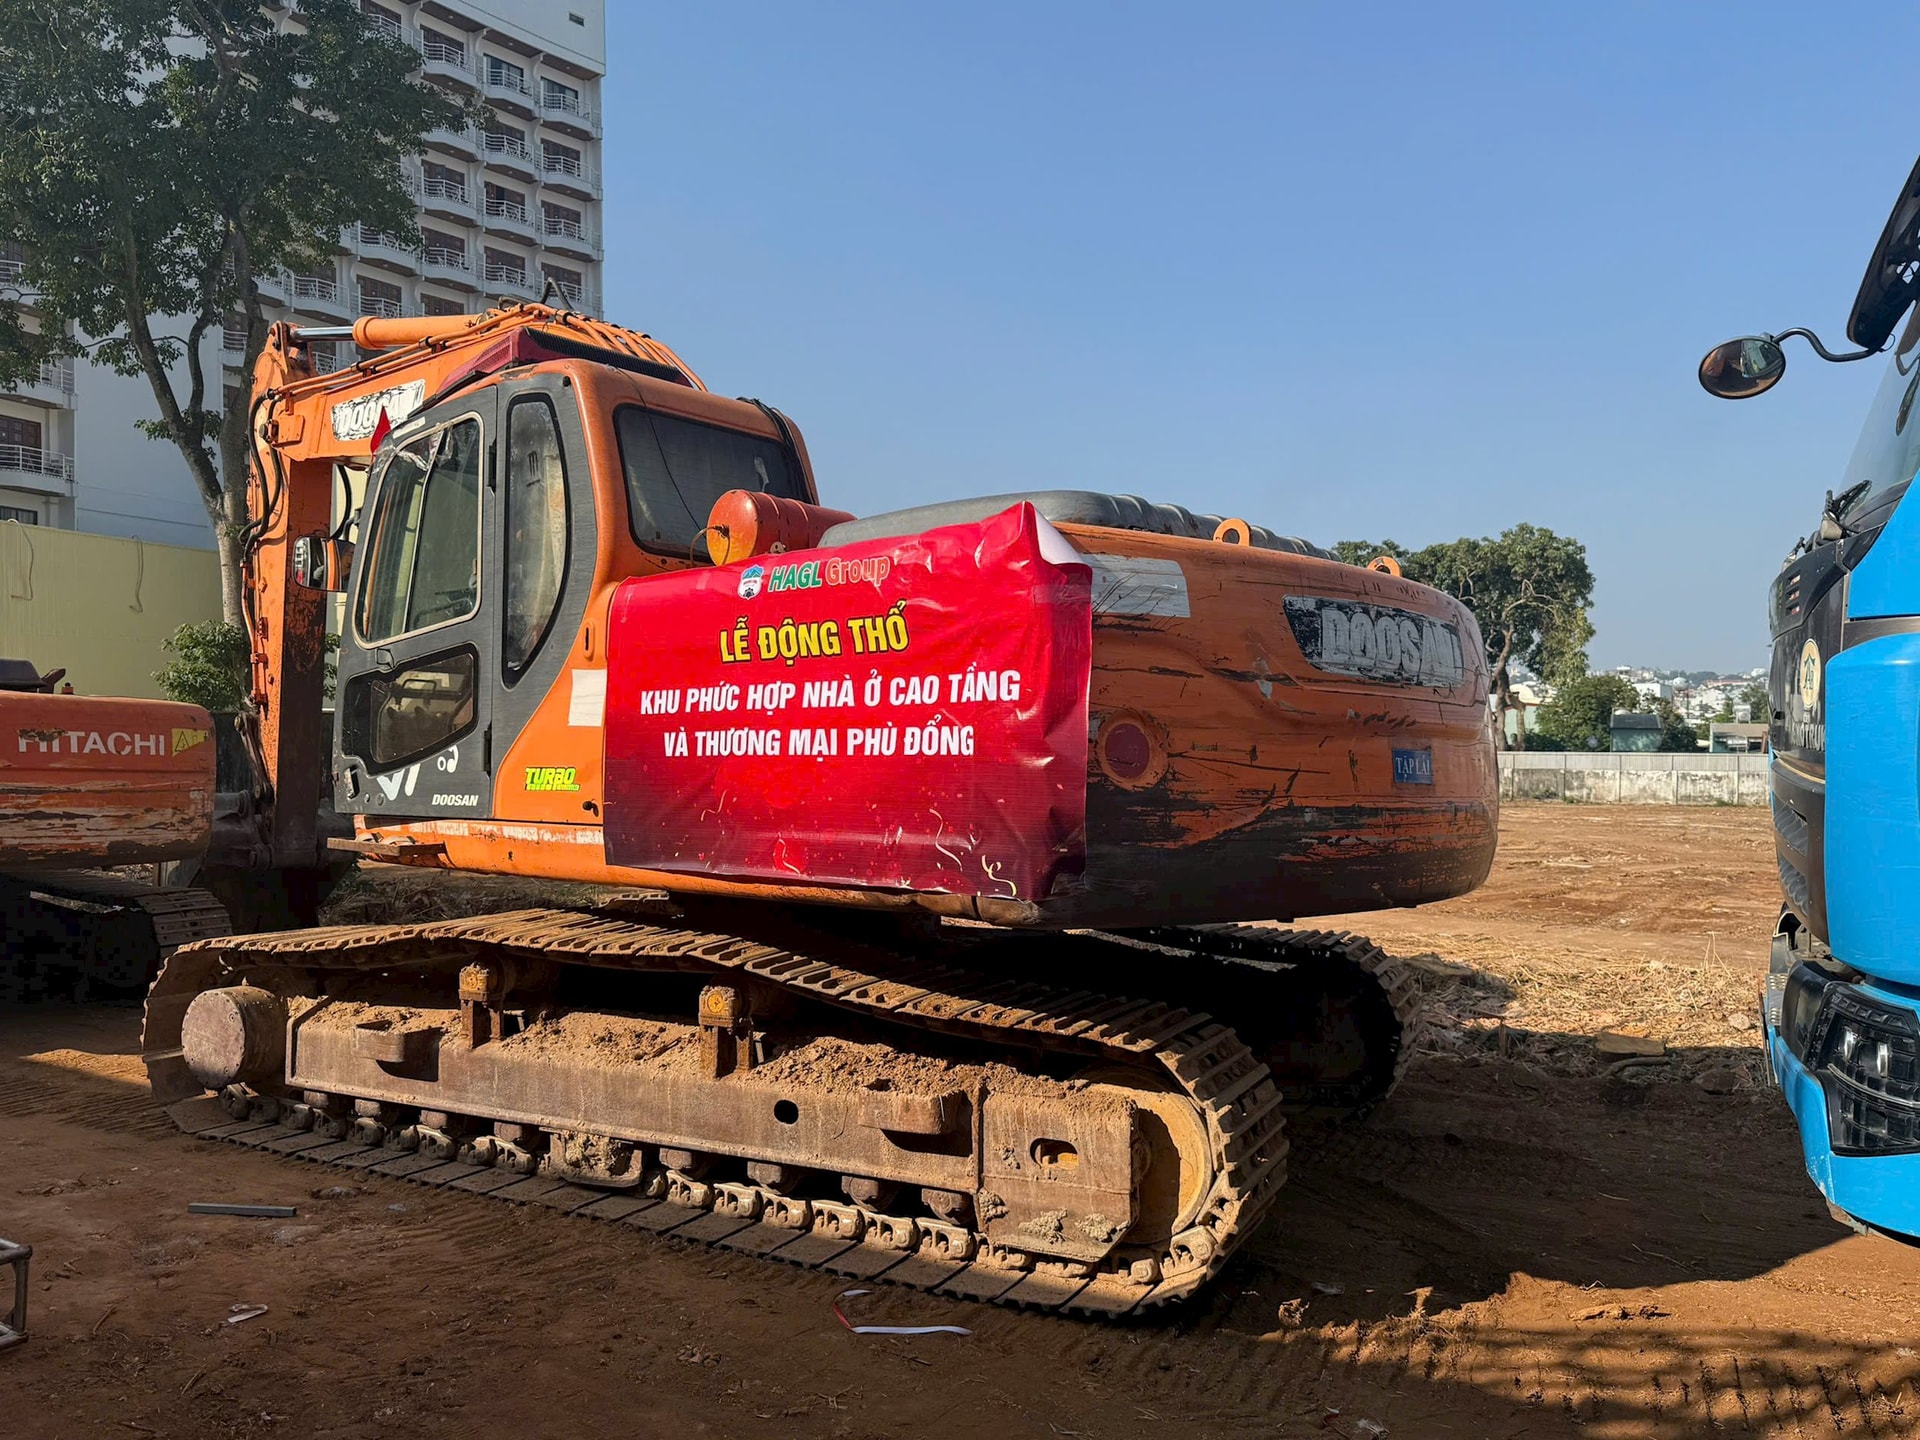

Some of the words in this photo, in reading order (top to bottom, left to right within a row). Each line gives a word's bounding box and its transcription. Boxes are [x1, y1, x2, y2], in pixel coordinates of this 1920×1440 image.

[768, 561, 822, 592] HAGL
[825, 556, 890, 587] Group
[719, 616, 751, 663] LỄ
[758, 617, 842, 666] ĐỘNG
[848, 600, 909, 653] THỔ
[640, 689, 681, 715] KHU
[685, 681, 740, 713] PHỨC
[746, 681, 796, 715] HỢP
[802, 674, 855, 708] NHÀ
[864, 669, 882, 707] Ở
[889, 675, 940, 706] CAO
[948, 661, 1021, 703] TẦNG
[18, 729, 165, 756] HITACHI
[664, 727, 689, 757] VÀ
[695, 727, 781, 757] THƯƠNG
[788, 728, 837, 762] MẠI
[847, 721, 897, 756] PHÙ
[904, 714, 974, 756] ĐỔNG
[525, 767, 576, 784] TURBO
[432, 794, 479, 806] DOOSAN
